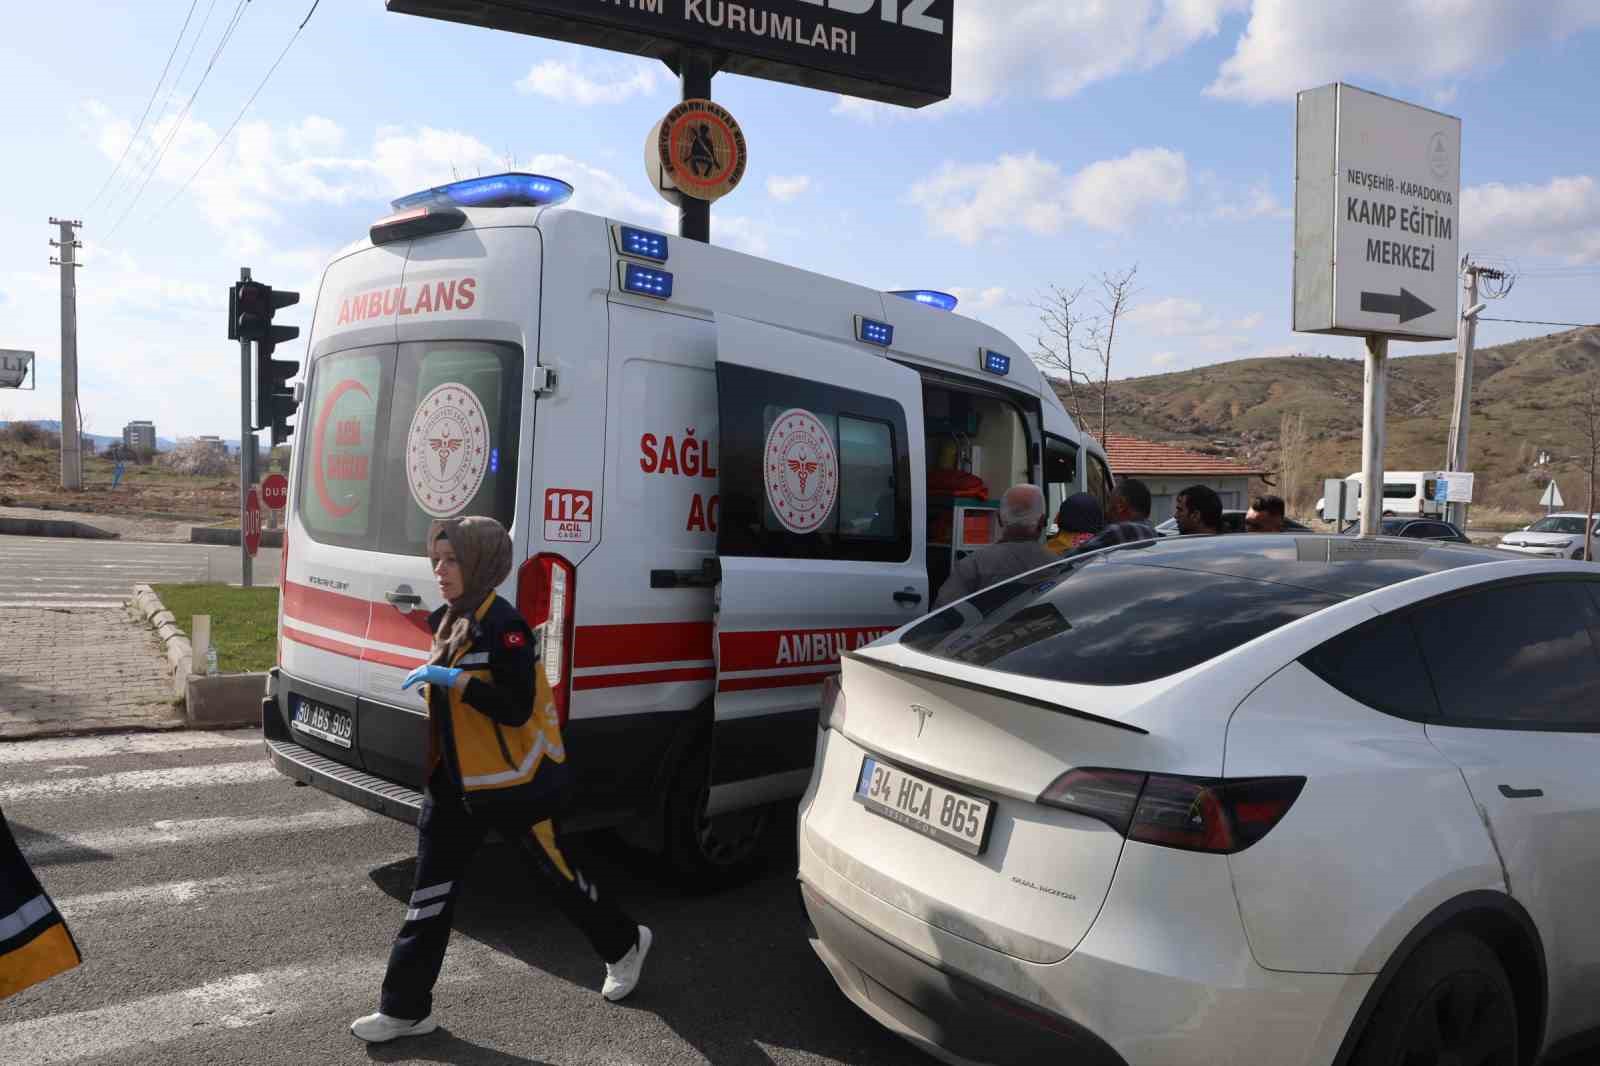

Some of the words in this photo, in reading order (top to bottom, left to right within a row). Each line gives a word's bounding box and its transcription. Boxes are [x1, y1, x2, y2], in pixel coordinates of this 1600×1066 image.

[684, 0, 857, 56] KURUMLARI
[1347, 168, 1394, 192] NEVŞEHİR
[1400, 179, 1452, 205] KAPADOKYA
[1347, 196, 1396, 228] KAMP
[1400, 206, 1452, 240] EĞİTİM
[1366, 238, 1434, 272] MERKEZİ
[337, 277, 476, 326] AMBULANS
[640, 427, 720, 478] SAĞL
[265, 487, 288, 497] DUR
[548, 492, 590, 520] 112
[311, 704, 330, 731] ABS
[870, 766, 891, 801] 34
[896, 777, 932, 819] HCA
[940, 794, 981, 838] 865
